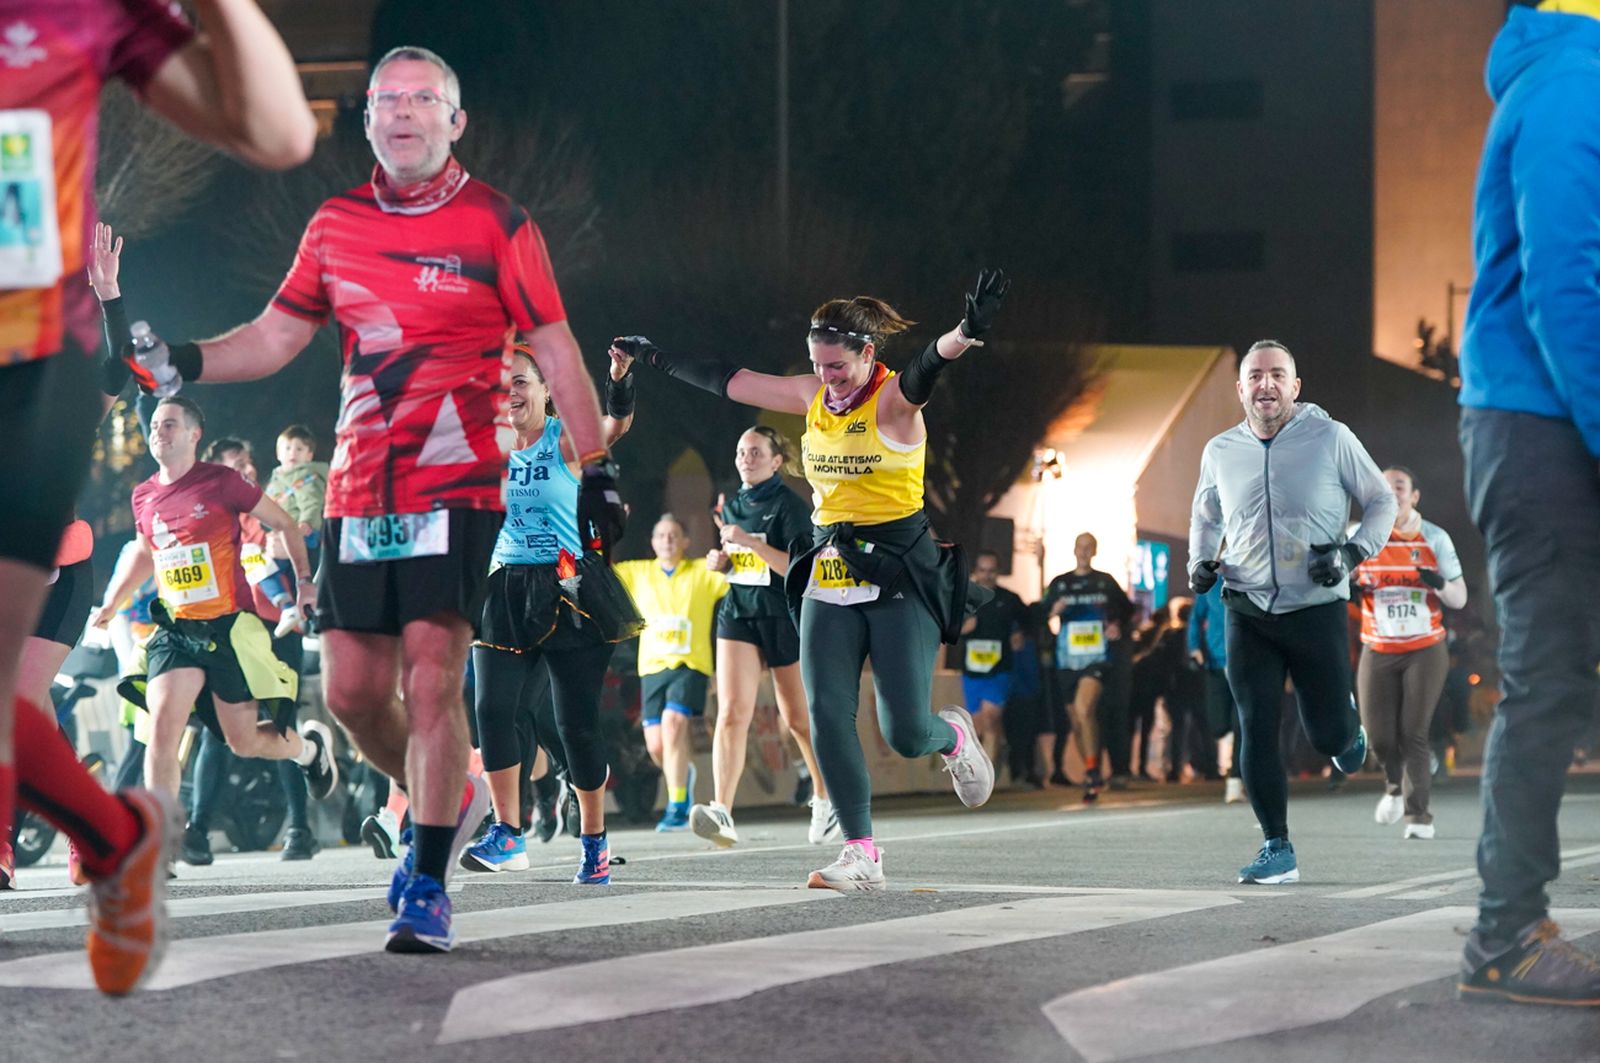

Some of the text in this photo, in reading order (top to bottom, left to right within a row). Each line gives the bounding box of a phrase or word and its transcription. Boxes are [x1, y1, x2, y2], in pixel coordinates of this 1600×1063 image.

[807, 453, 882, 463] CLUB ATLETISMO
[813, 464, 874, 474] MONTILLA
[507, 488, 540, 497] TISMO
[165, 565, 203, 586] 6469
[1387, 604, 1418, 619] 6174
